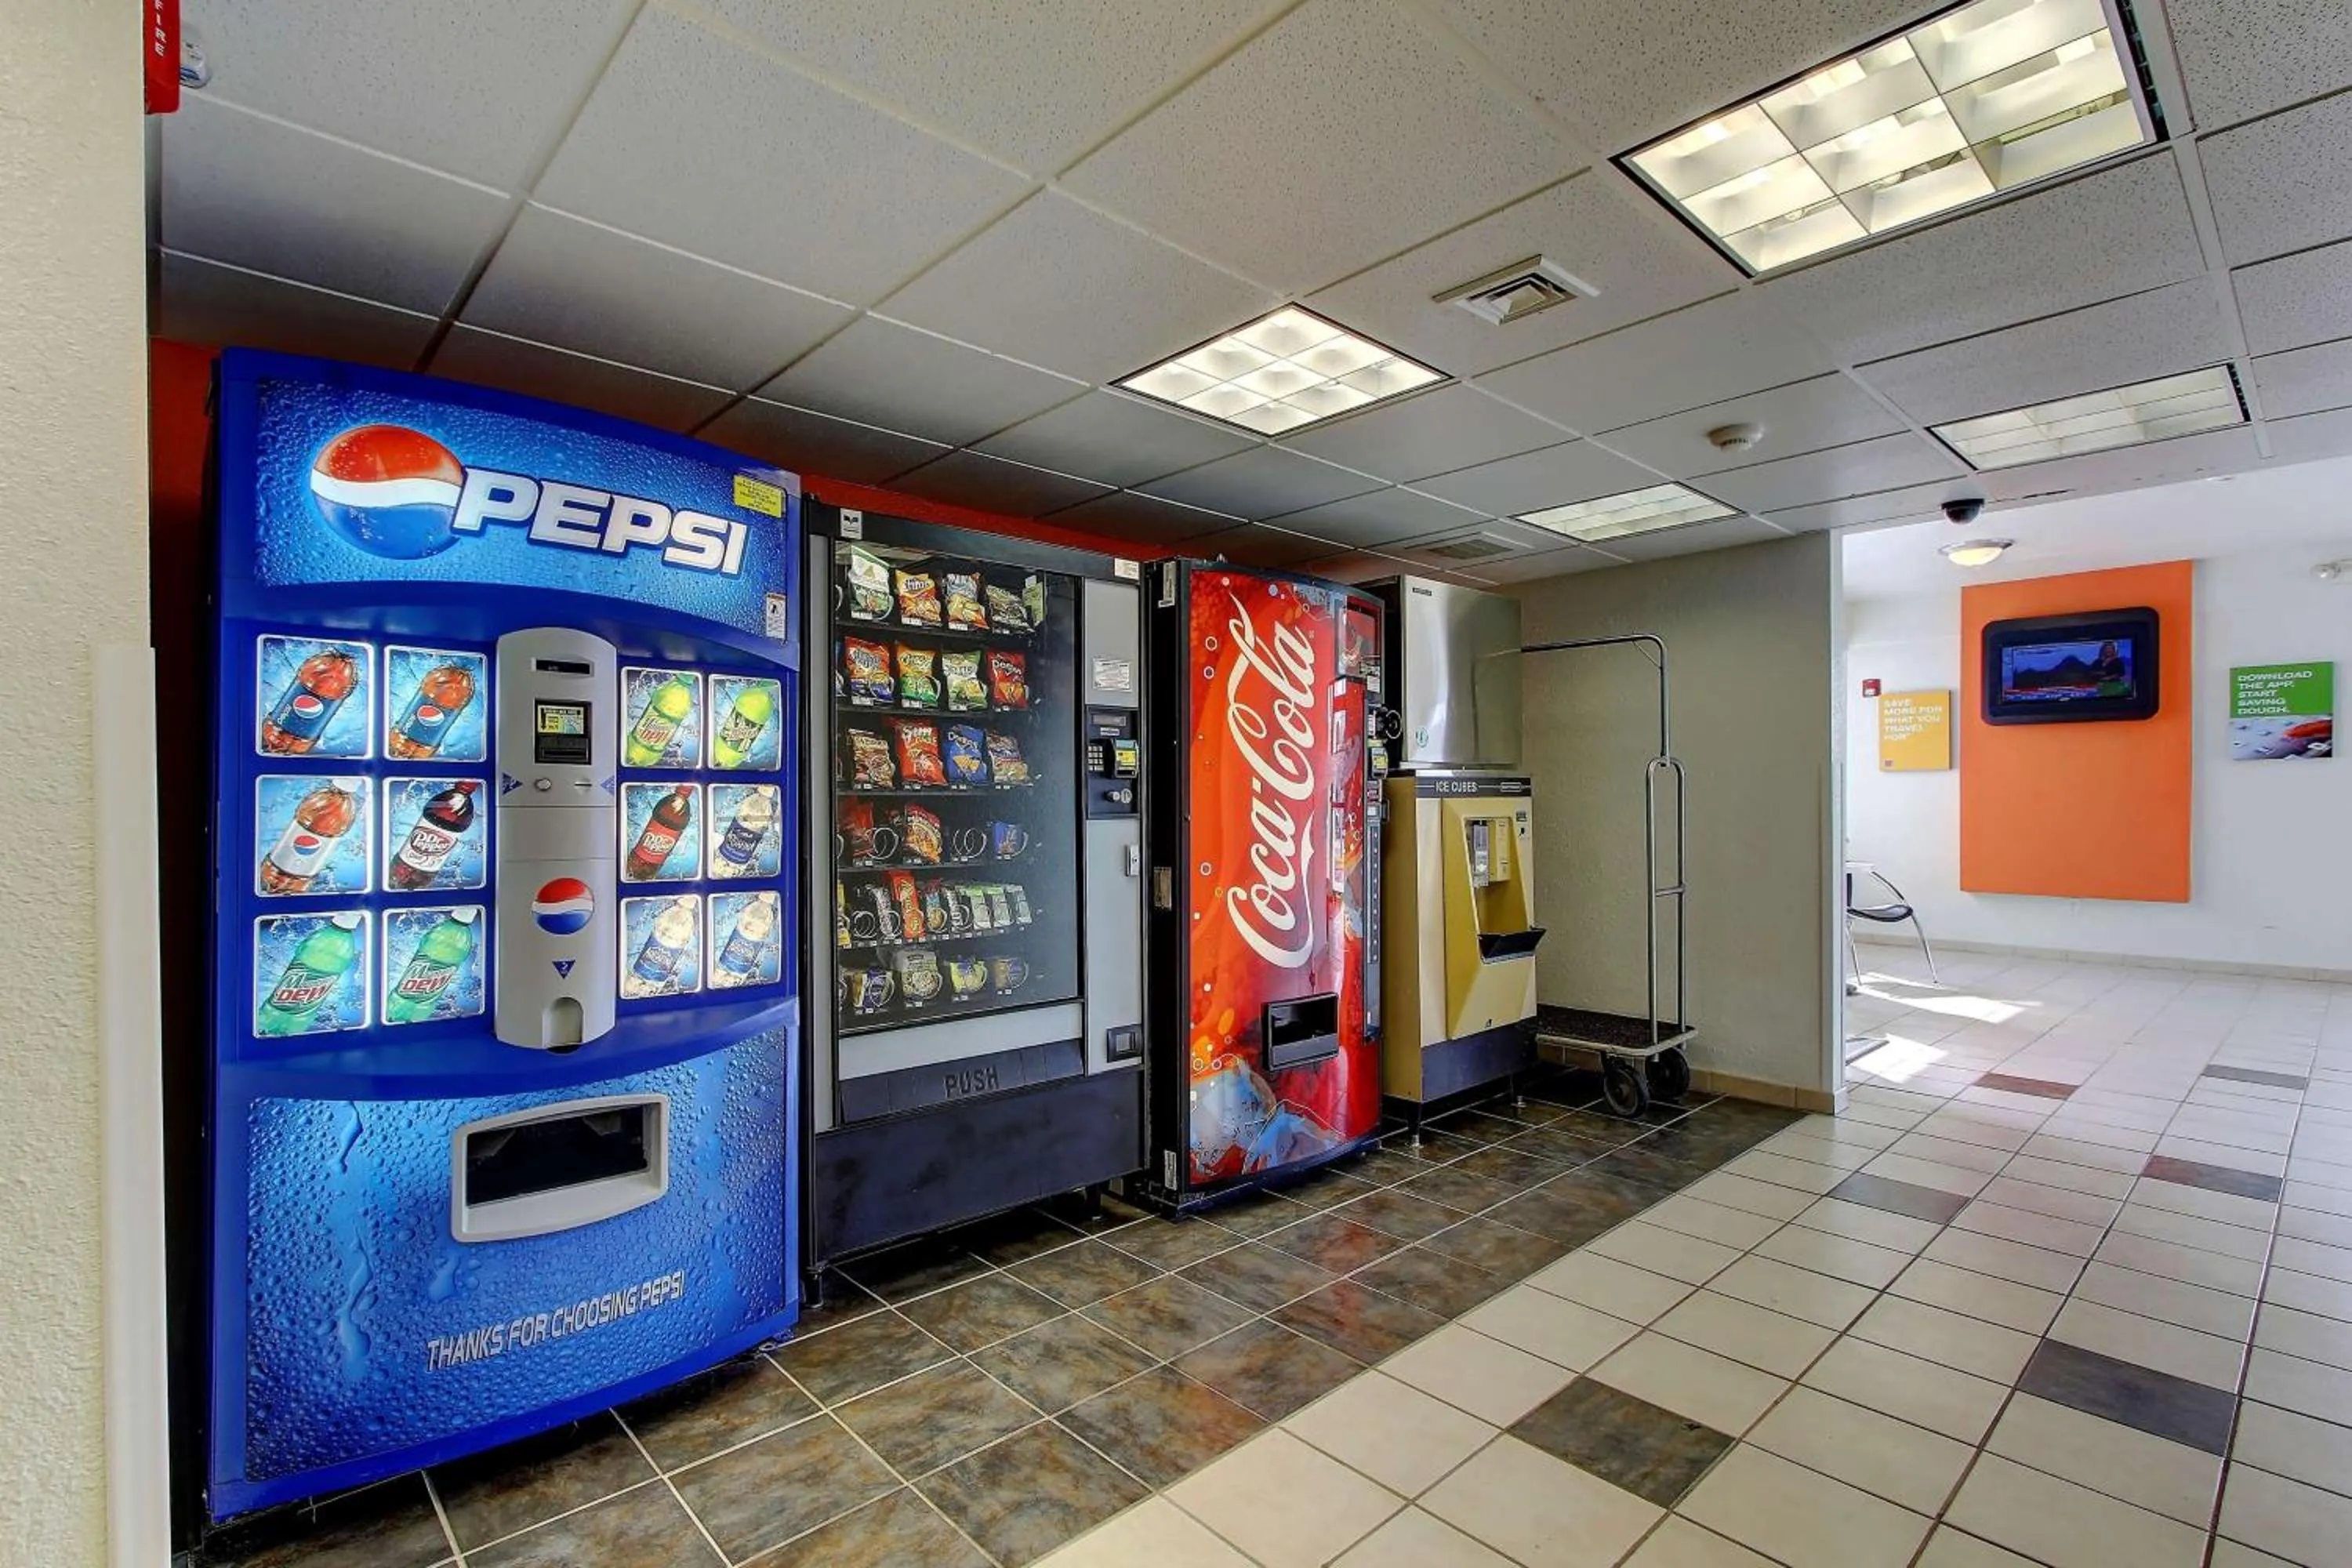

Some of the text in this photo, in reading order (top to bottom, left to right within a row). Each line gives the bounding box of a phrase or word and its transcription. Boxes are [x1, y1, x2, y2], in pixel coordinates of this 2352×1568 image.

[452, 468, 747, 575] PEPSI
[2238, 670, 2313, 681] DOWNLOAD
[2238, 689, 2278, 698] START
[2238, 697, 2286, 706] SAVING
[1227, 592, 1315, 969] Coca-Cola
[1436, 781, 1449, 793] ICE
[943, 1065, 999, 1098] PUSH
[426, 1269, 684, 1372] THANKS FOR CHOOSING PEPSI
